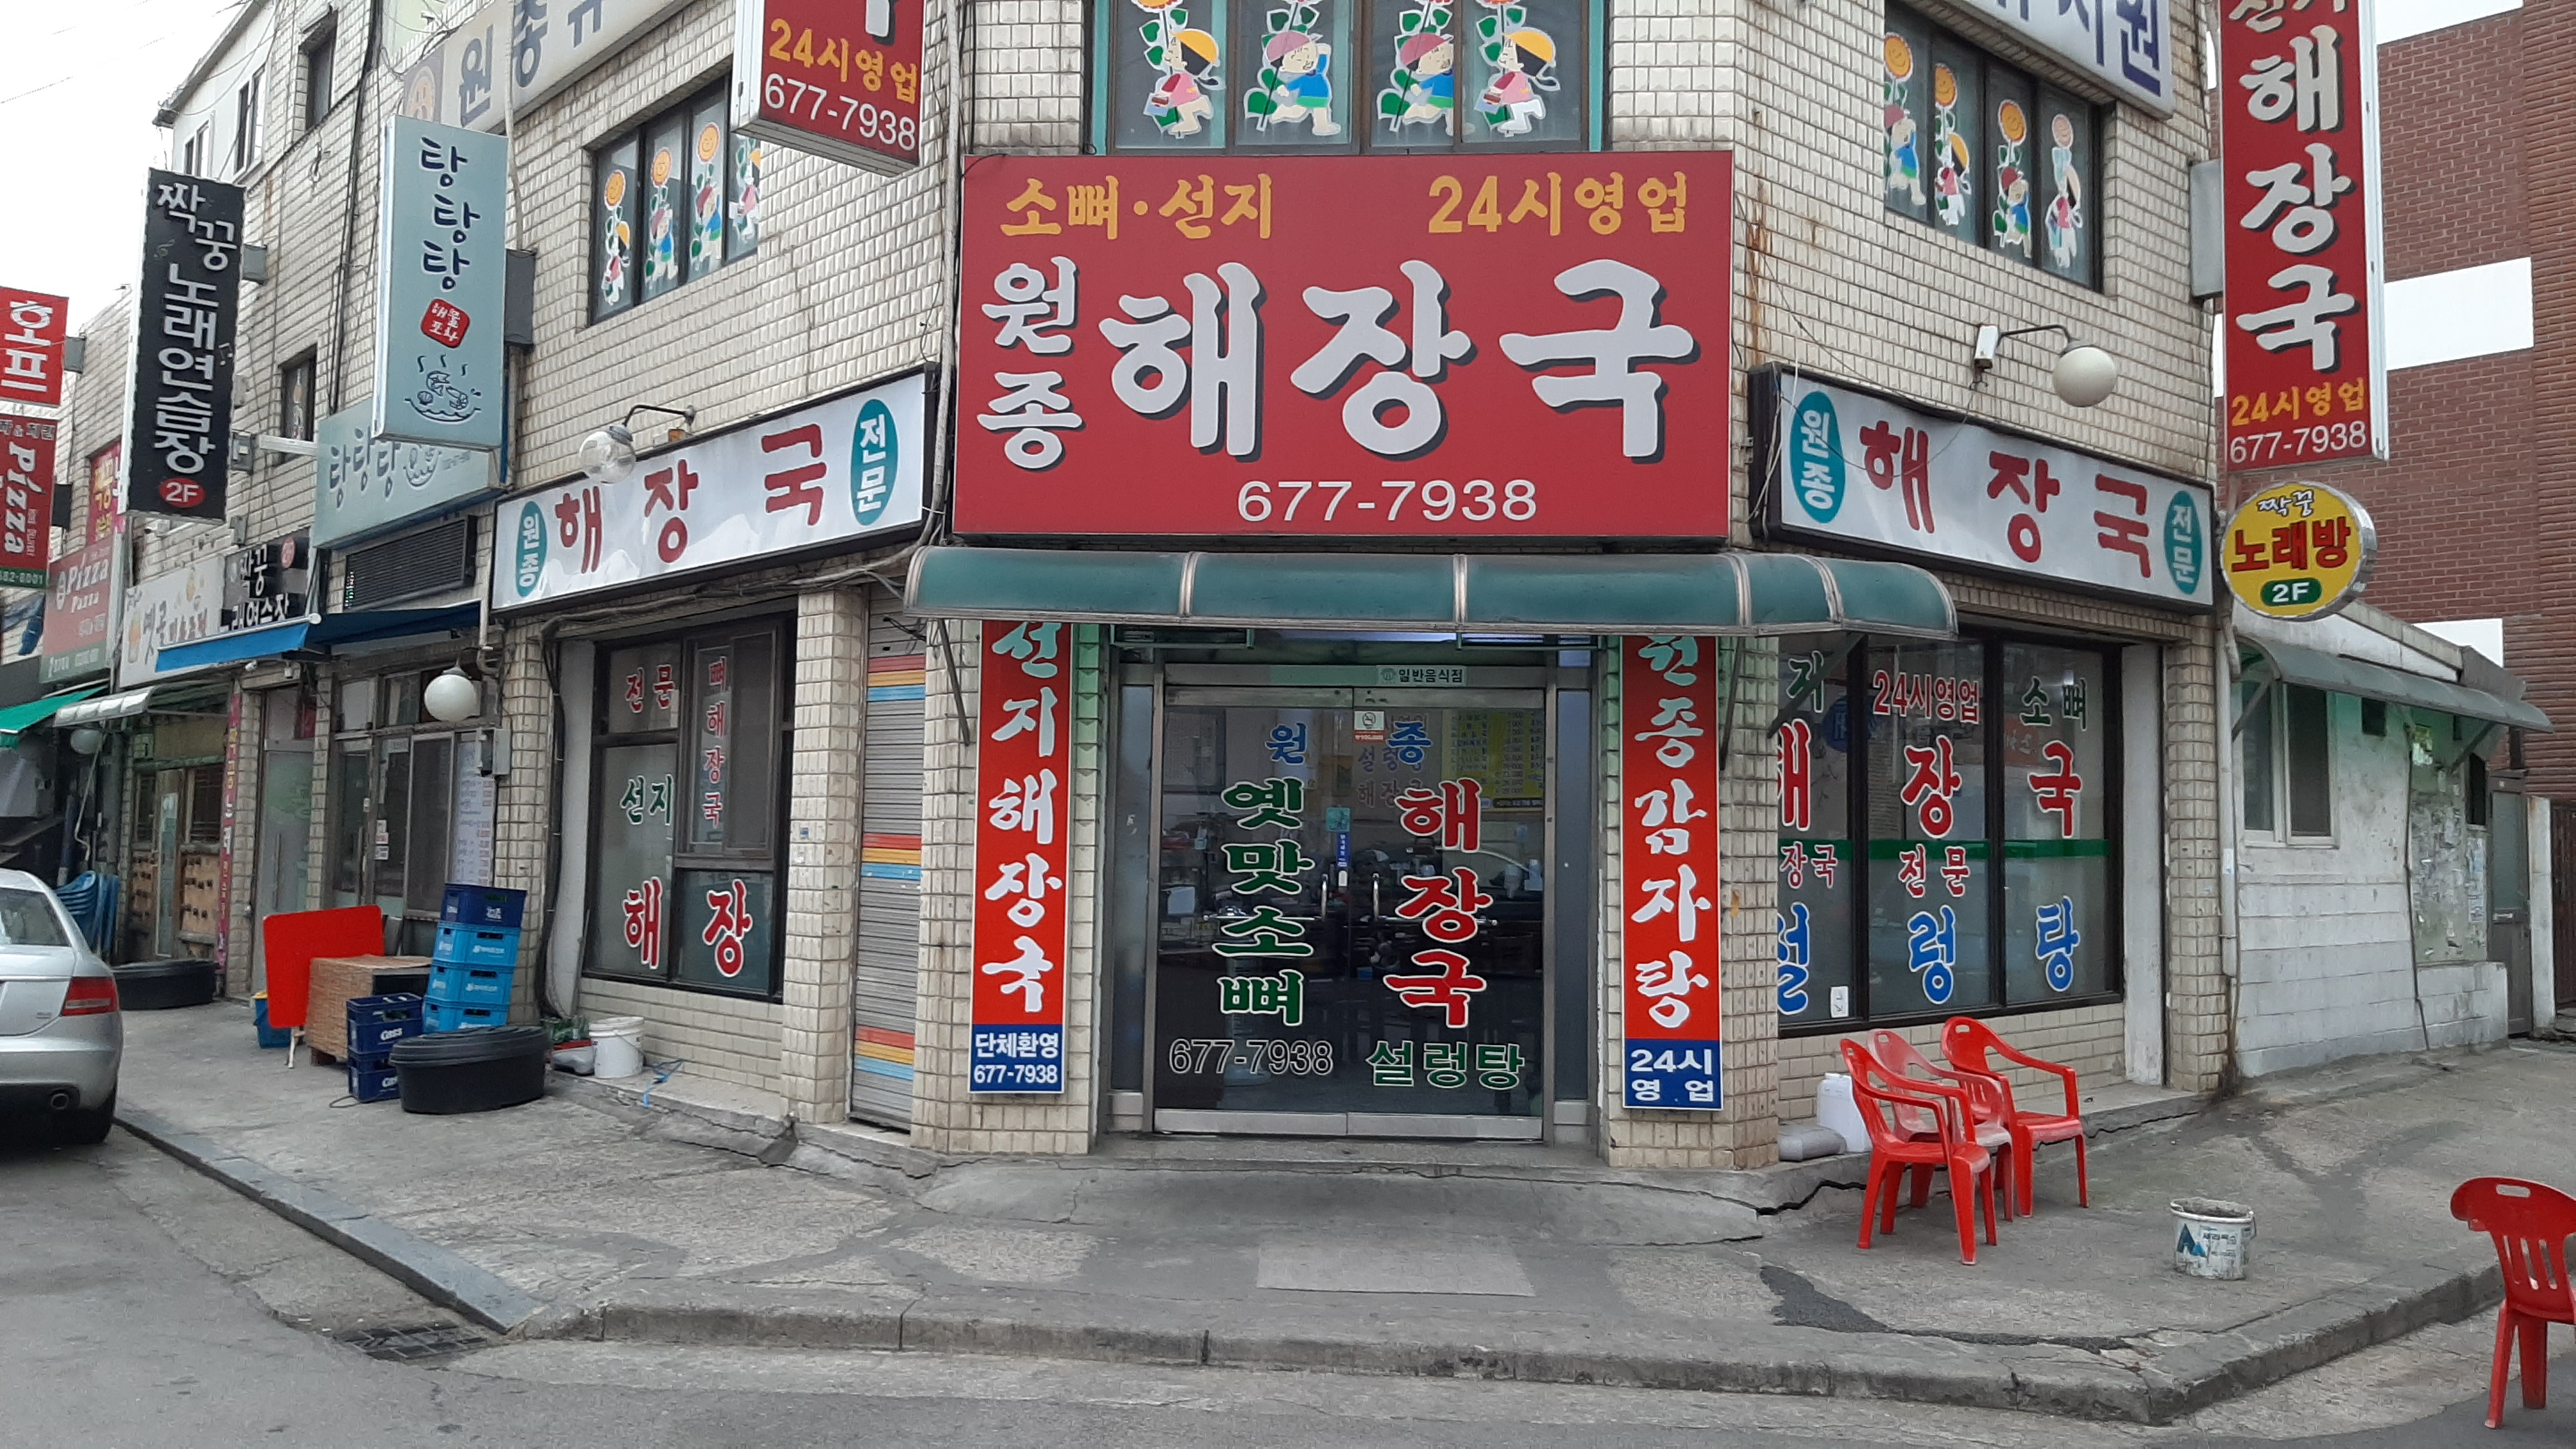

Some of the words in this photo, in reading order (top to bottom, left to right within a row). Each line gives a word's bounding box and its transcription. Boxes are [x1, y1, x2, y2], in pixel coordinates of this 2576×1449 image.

[769, 18, 917, 103] 24시영업
[765, 73, 916, 151] 677-7938
[157, 183, 238, 272] 짝꿍
[421, 137, 480, 291] 탕탕탕
[1429, 171, 1688, 237] 24시영업
[2236, 25, 2359, 373] 해장국
[1, 300, 54, 392] 호프
[153, 263, 219, 475] 노래연습장
[977, 256, 1084, 471] 원종
[1098, 257, 1702, 465] 해장국
[2231, 378, 2365, 426] 24시영업
[330, 426, 401, 509] 탕탕탕
[856, 413, 887, 513] 전문
[1799, 409, 1835, 510] 원종
[2230, 420, 2367, 464] 677-7938
[4, 441, 45, 554] Pizza
[165, 482, 199, 502] 2F
[555, 422, 827, 574] 해장국
[1236, 479, 1537, 523] 677-7938
[1860, 420, 2151, 578] 해장국
[2258, 489, 2315, 517] 짝꿍
[519, 513, 540, 589] 원종
[2174, 504, 2192, 585] 전문
[2231, 520, 2351, 573] 노래방
[2272, 582, 2310, 603] 2F
[625, 664, 675, 714] 전문
[1399, 668, 1463, 683] 일반음식점
[1872, 670, 1979, 723] 24시영업
[2020, 677, 2088, 730] 소뼈
[703, 656, 727, 829] 뼈해장국
[620, 774, 674, 825] 선지
[981, 622, 1062, 1015] 선지해장국
[1383, 777, 1493, 1029] 해장국
[1898, 844, 1971, 898] 전문
[974, 1064, 1058, 1085] 677-7938
[975, 1032, 1059, 1060] 단체환영
[1169, 1038, 1333, 1076] 677-7938
[1367, 1039, 1526, 1090] 설렁탕
[1630, 1048, 1713, 1075] 24시
[1631, 1078, 1714, 1103] 영업
